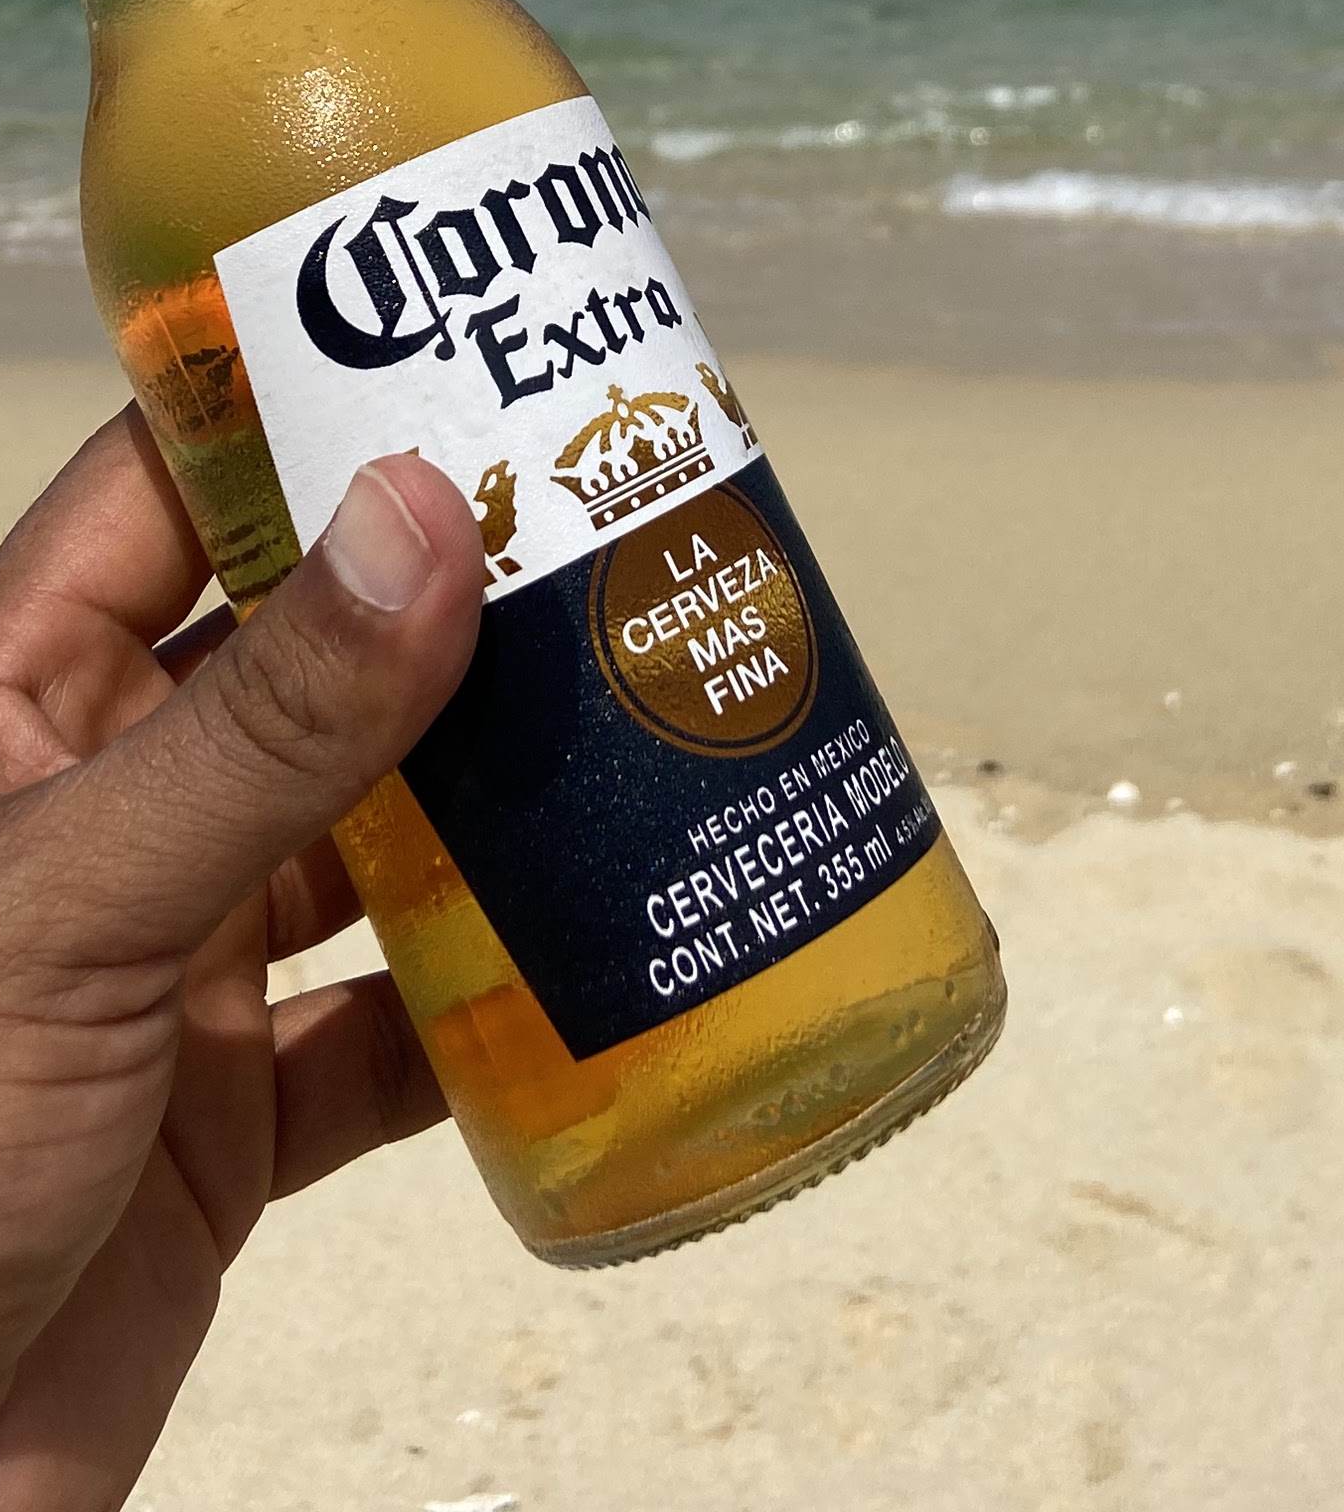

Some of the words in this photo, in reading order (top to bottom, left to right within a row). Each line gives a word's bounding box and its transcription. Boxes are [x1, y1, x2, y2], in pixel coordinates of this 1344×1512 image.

[465, 277, 682, 409] Extra
[622, 548, 778, 654] CERVEZA
[663, 533, 718, 582] LA
[687, 605, 766, 673] MAS
[704, 646, 789, 715] FINA
[646, 793, 849, 938] CERVECERIA
[842, 735, 910, 819] MODELO
[687, 786, 776, 855] HECHO
[778, 762, 811, 801] EN
[810, 719, 870, 779] MEXICO
[648, 921, 750, 996] CONT.
[748, 878, 821, 943] NET.
[817, 844, 865, 899] 355
[863, 824, 893, 870] ml
